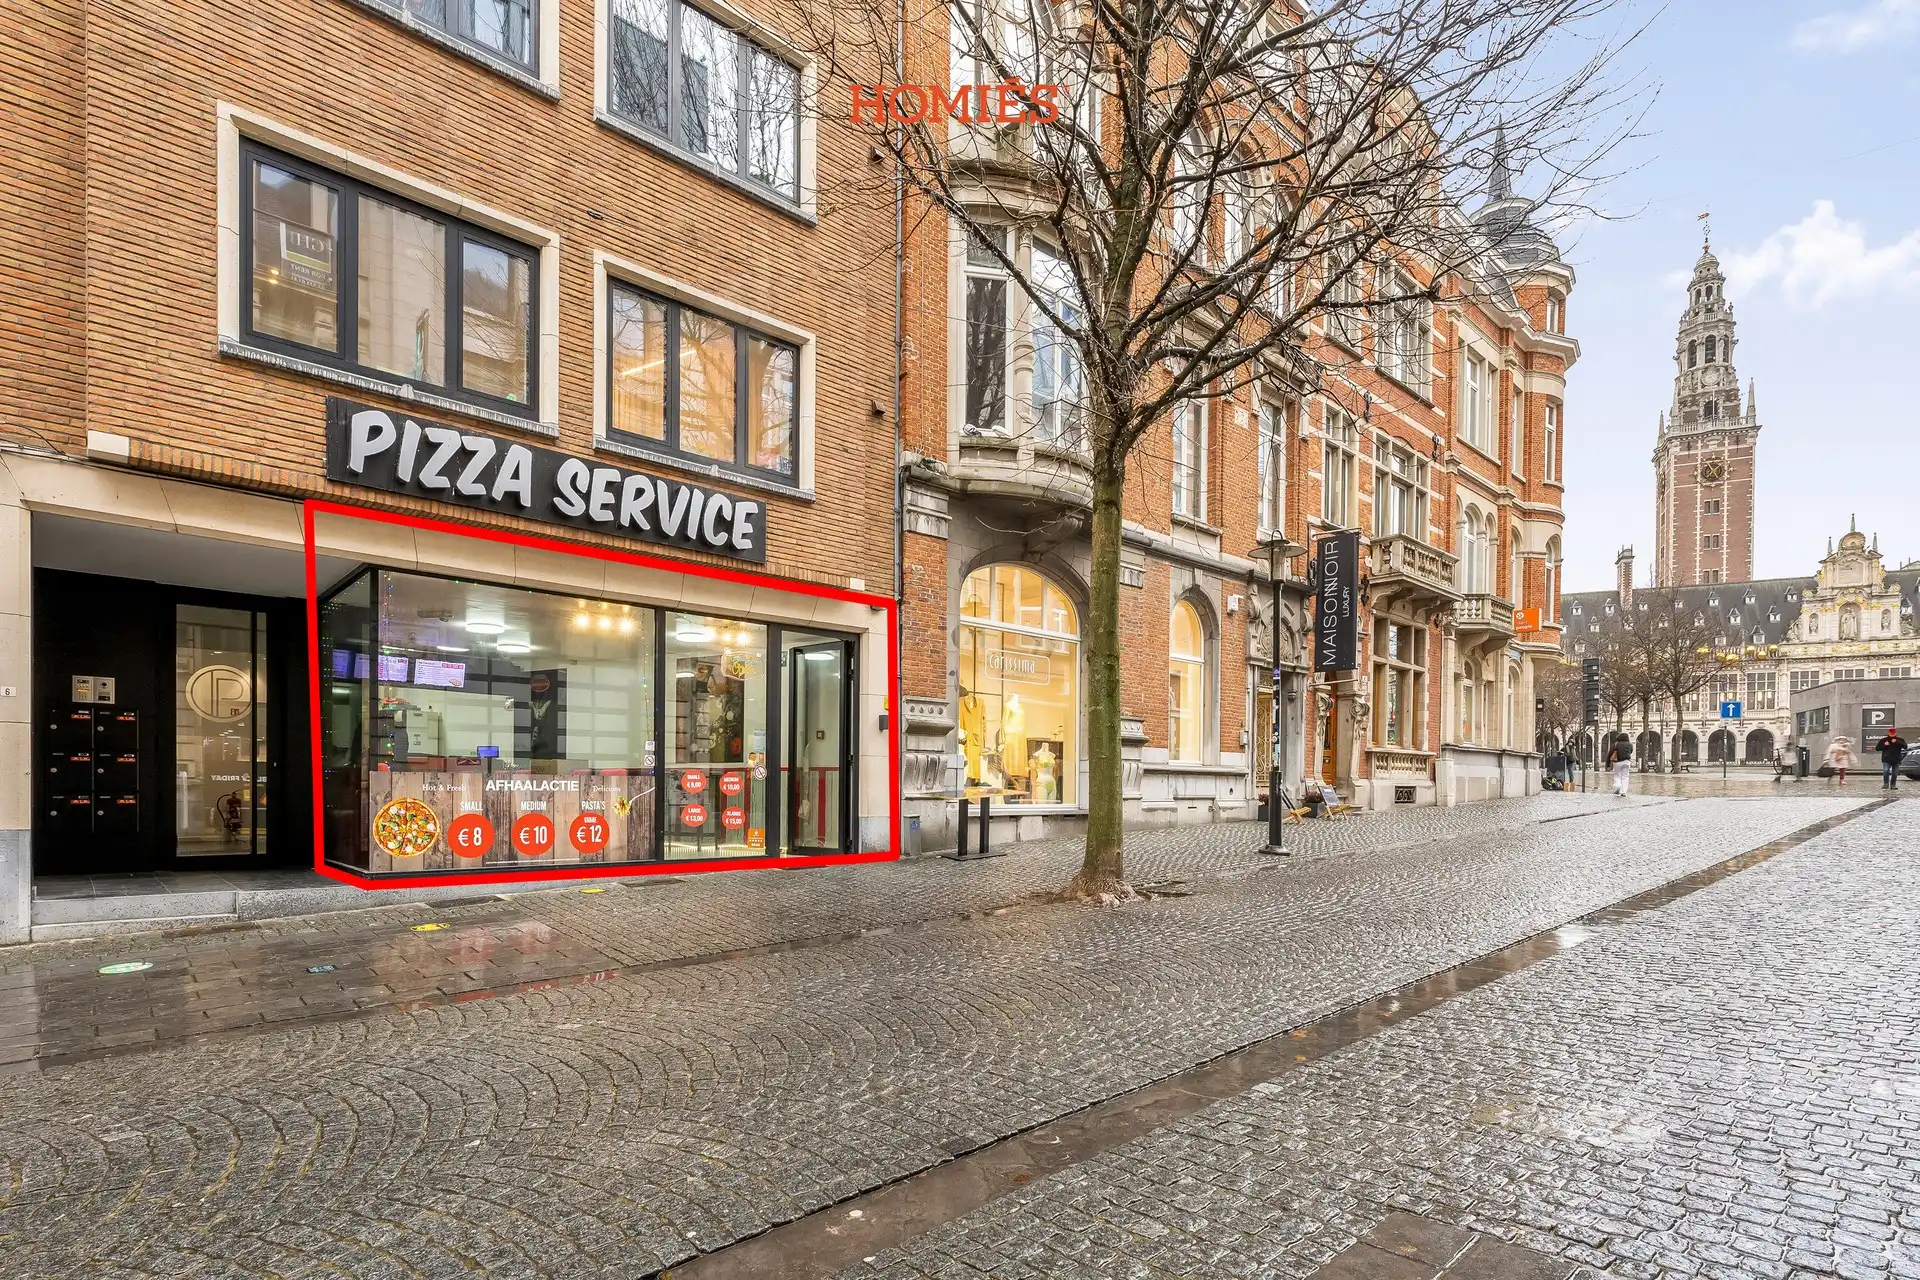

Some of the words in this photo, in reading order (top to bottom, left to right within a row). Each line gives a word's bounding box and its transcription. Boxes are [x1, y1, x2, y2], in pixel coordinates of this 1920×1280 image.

[349, 409, 533, 508] PIZZA
[552, 457, 758, 551] SERVICE
[1342, 585, 1350, 618] LUXURY
[5, 687, 11, 696] 6
[1825, 709, 1828, 719] P
[1871, 711, 1885, 725] P
[422, 784, 437, 792] Hot
[446, 783, 467, 792] Fresh
[485, 779, 580, 792] AFHAALACTIE
[592, 784, 622, 793] Delicious
[460, 800, 484, 812] SMALL
[520, 800, 547, 811] MEDIUM
[581, 800, 606, 811] PASTA'S
[533, 825, 548, 845] 10
[589, 824, 603, 843] 12
